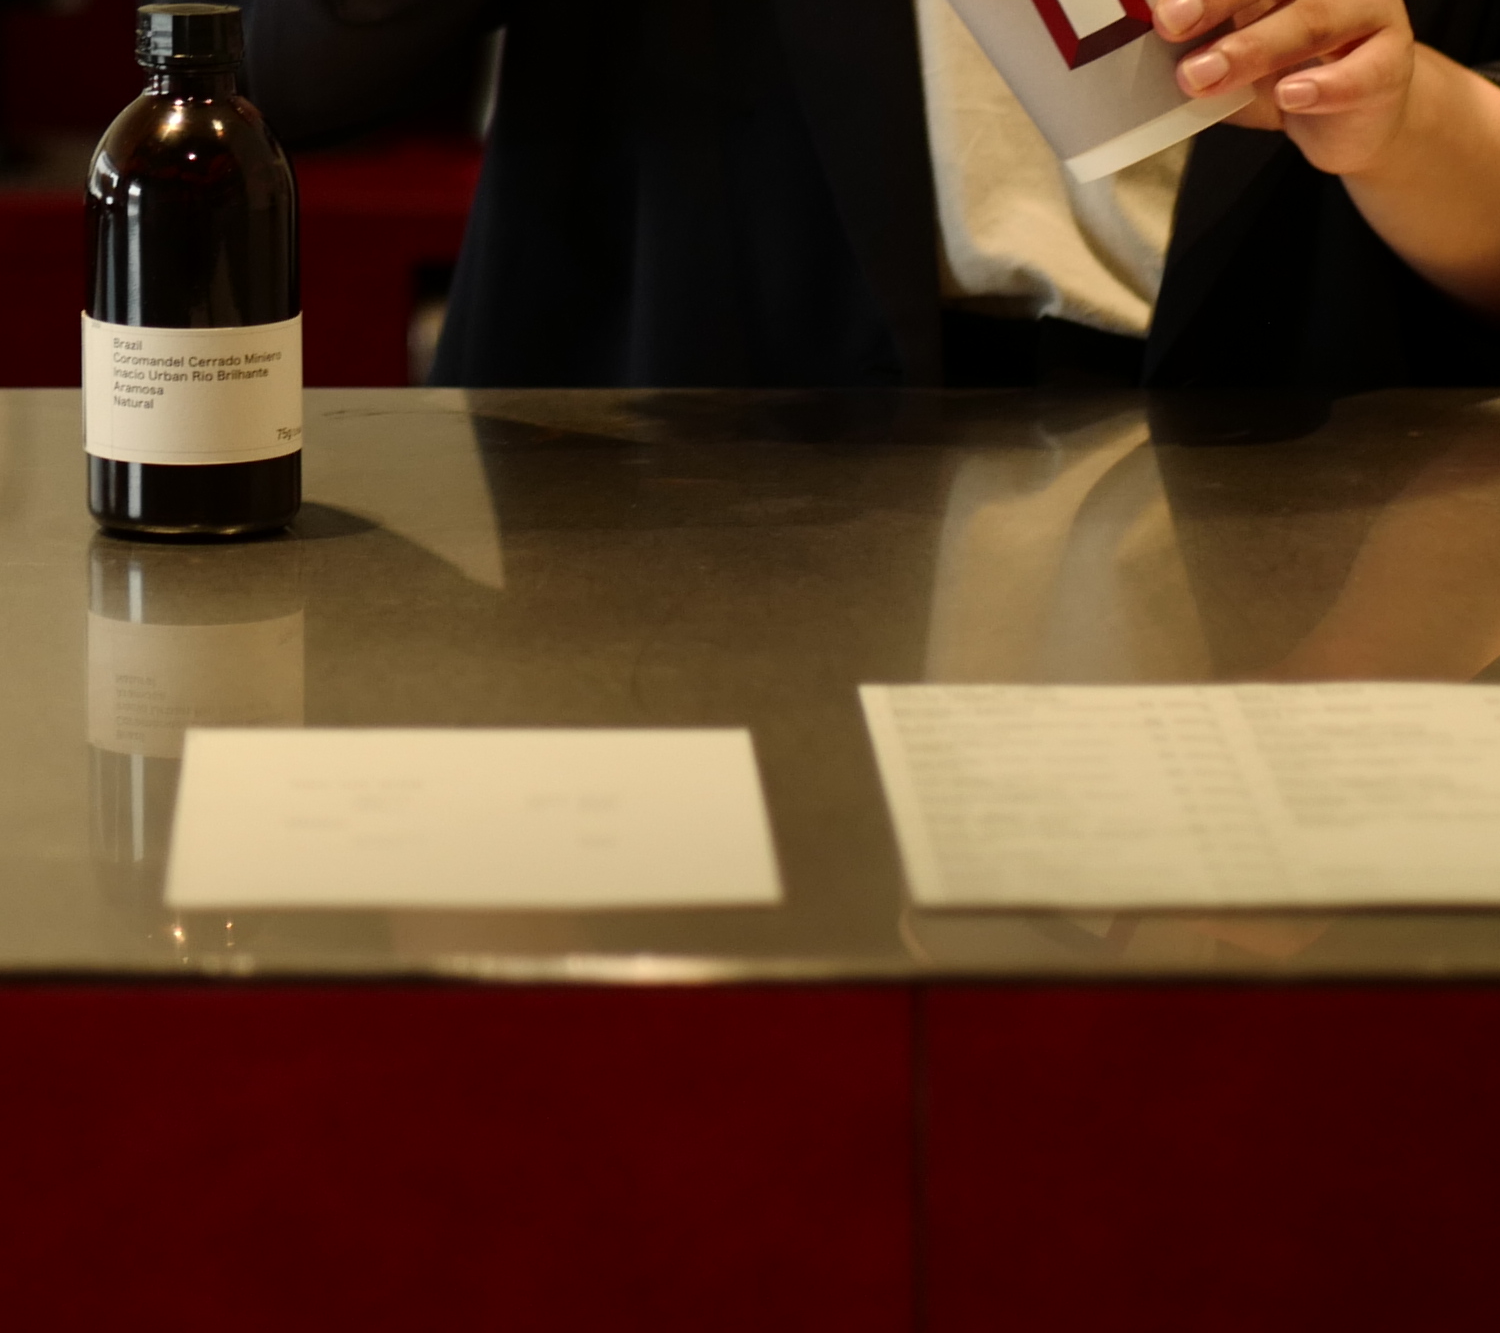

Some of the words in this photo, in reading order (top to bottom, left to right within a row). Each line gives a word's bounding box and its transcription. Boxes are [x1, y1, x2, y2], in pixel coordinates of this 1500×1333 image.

[113, 337, 143, 351] Brazil
[113, 352, 185, 368] Coromandel
[188, 355, 241, 368] Cerrado
[148, 370, 188, 382] Urban
[192, 370, 214, 382] Rio
[217, 368, 269, 382] Brilhante
[113, 381, 164, 395] Aramosa
[113, 395, 154, 409] Natural
